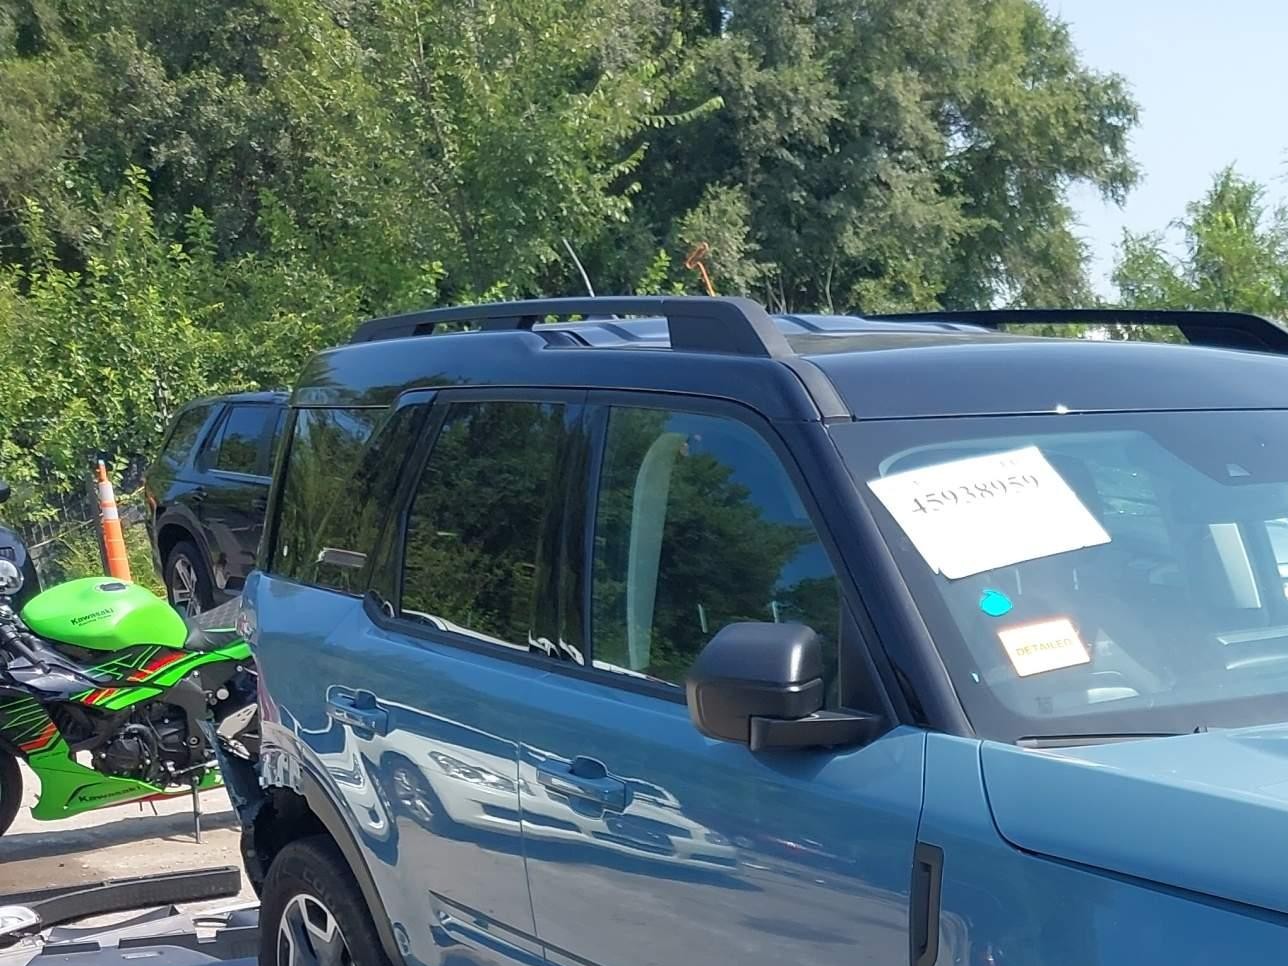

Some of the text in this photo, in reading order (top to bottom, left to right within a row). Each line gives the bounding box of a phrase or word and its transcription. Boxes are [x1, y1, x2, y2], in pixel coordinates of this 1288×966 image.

[911, 474, 1040, 515] 45938959
[70, 608, 114, 626] Kawasaki
[1016, 638, 1072, 656] DETAILED
